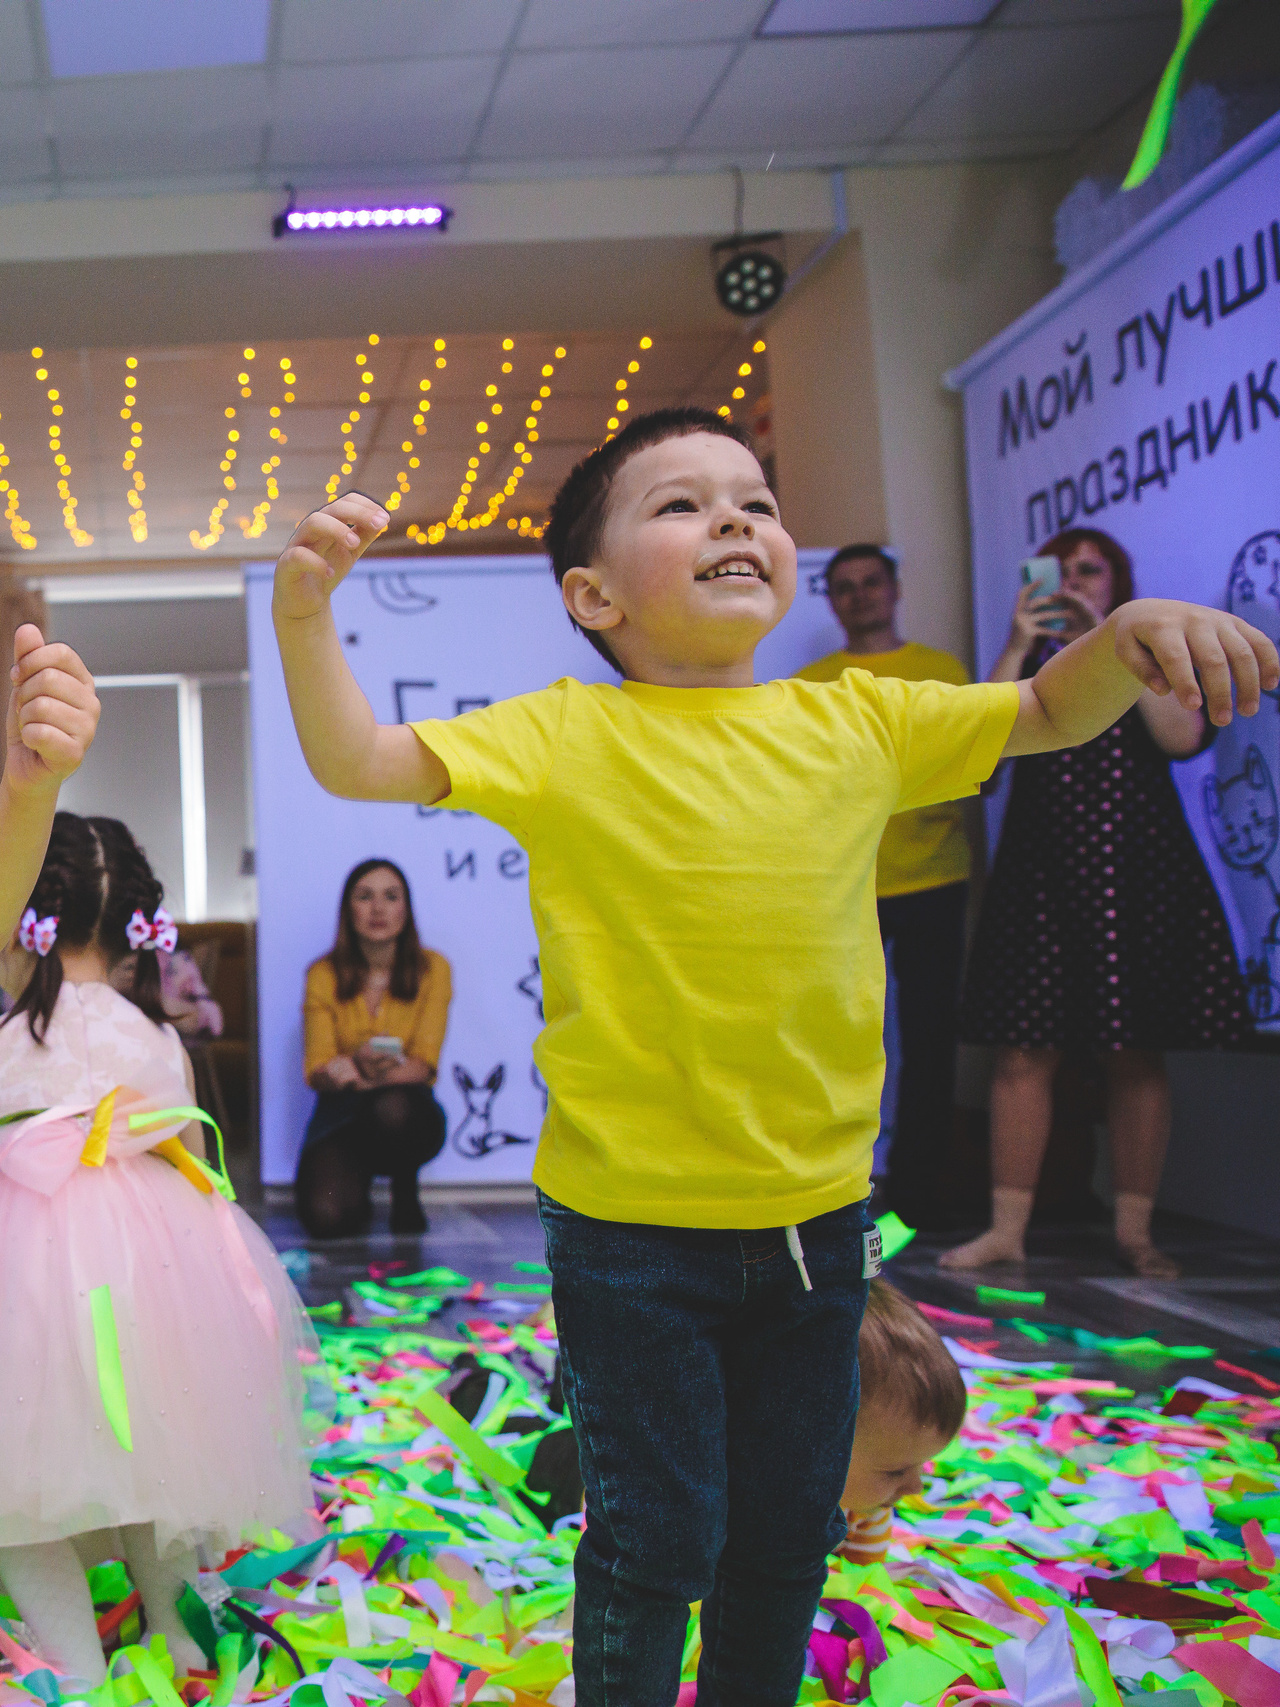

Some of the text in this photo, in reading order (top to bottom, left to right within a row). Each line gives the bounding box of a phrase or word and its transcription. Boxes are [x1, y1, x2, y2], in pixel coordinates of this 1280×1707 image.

[998, 331, 1094, 459] Мой
[1027, 359, 1280, 544] праздник
[444, 849, 477, 880] и
